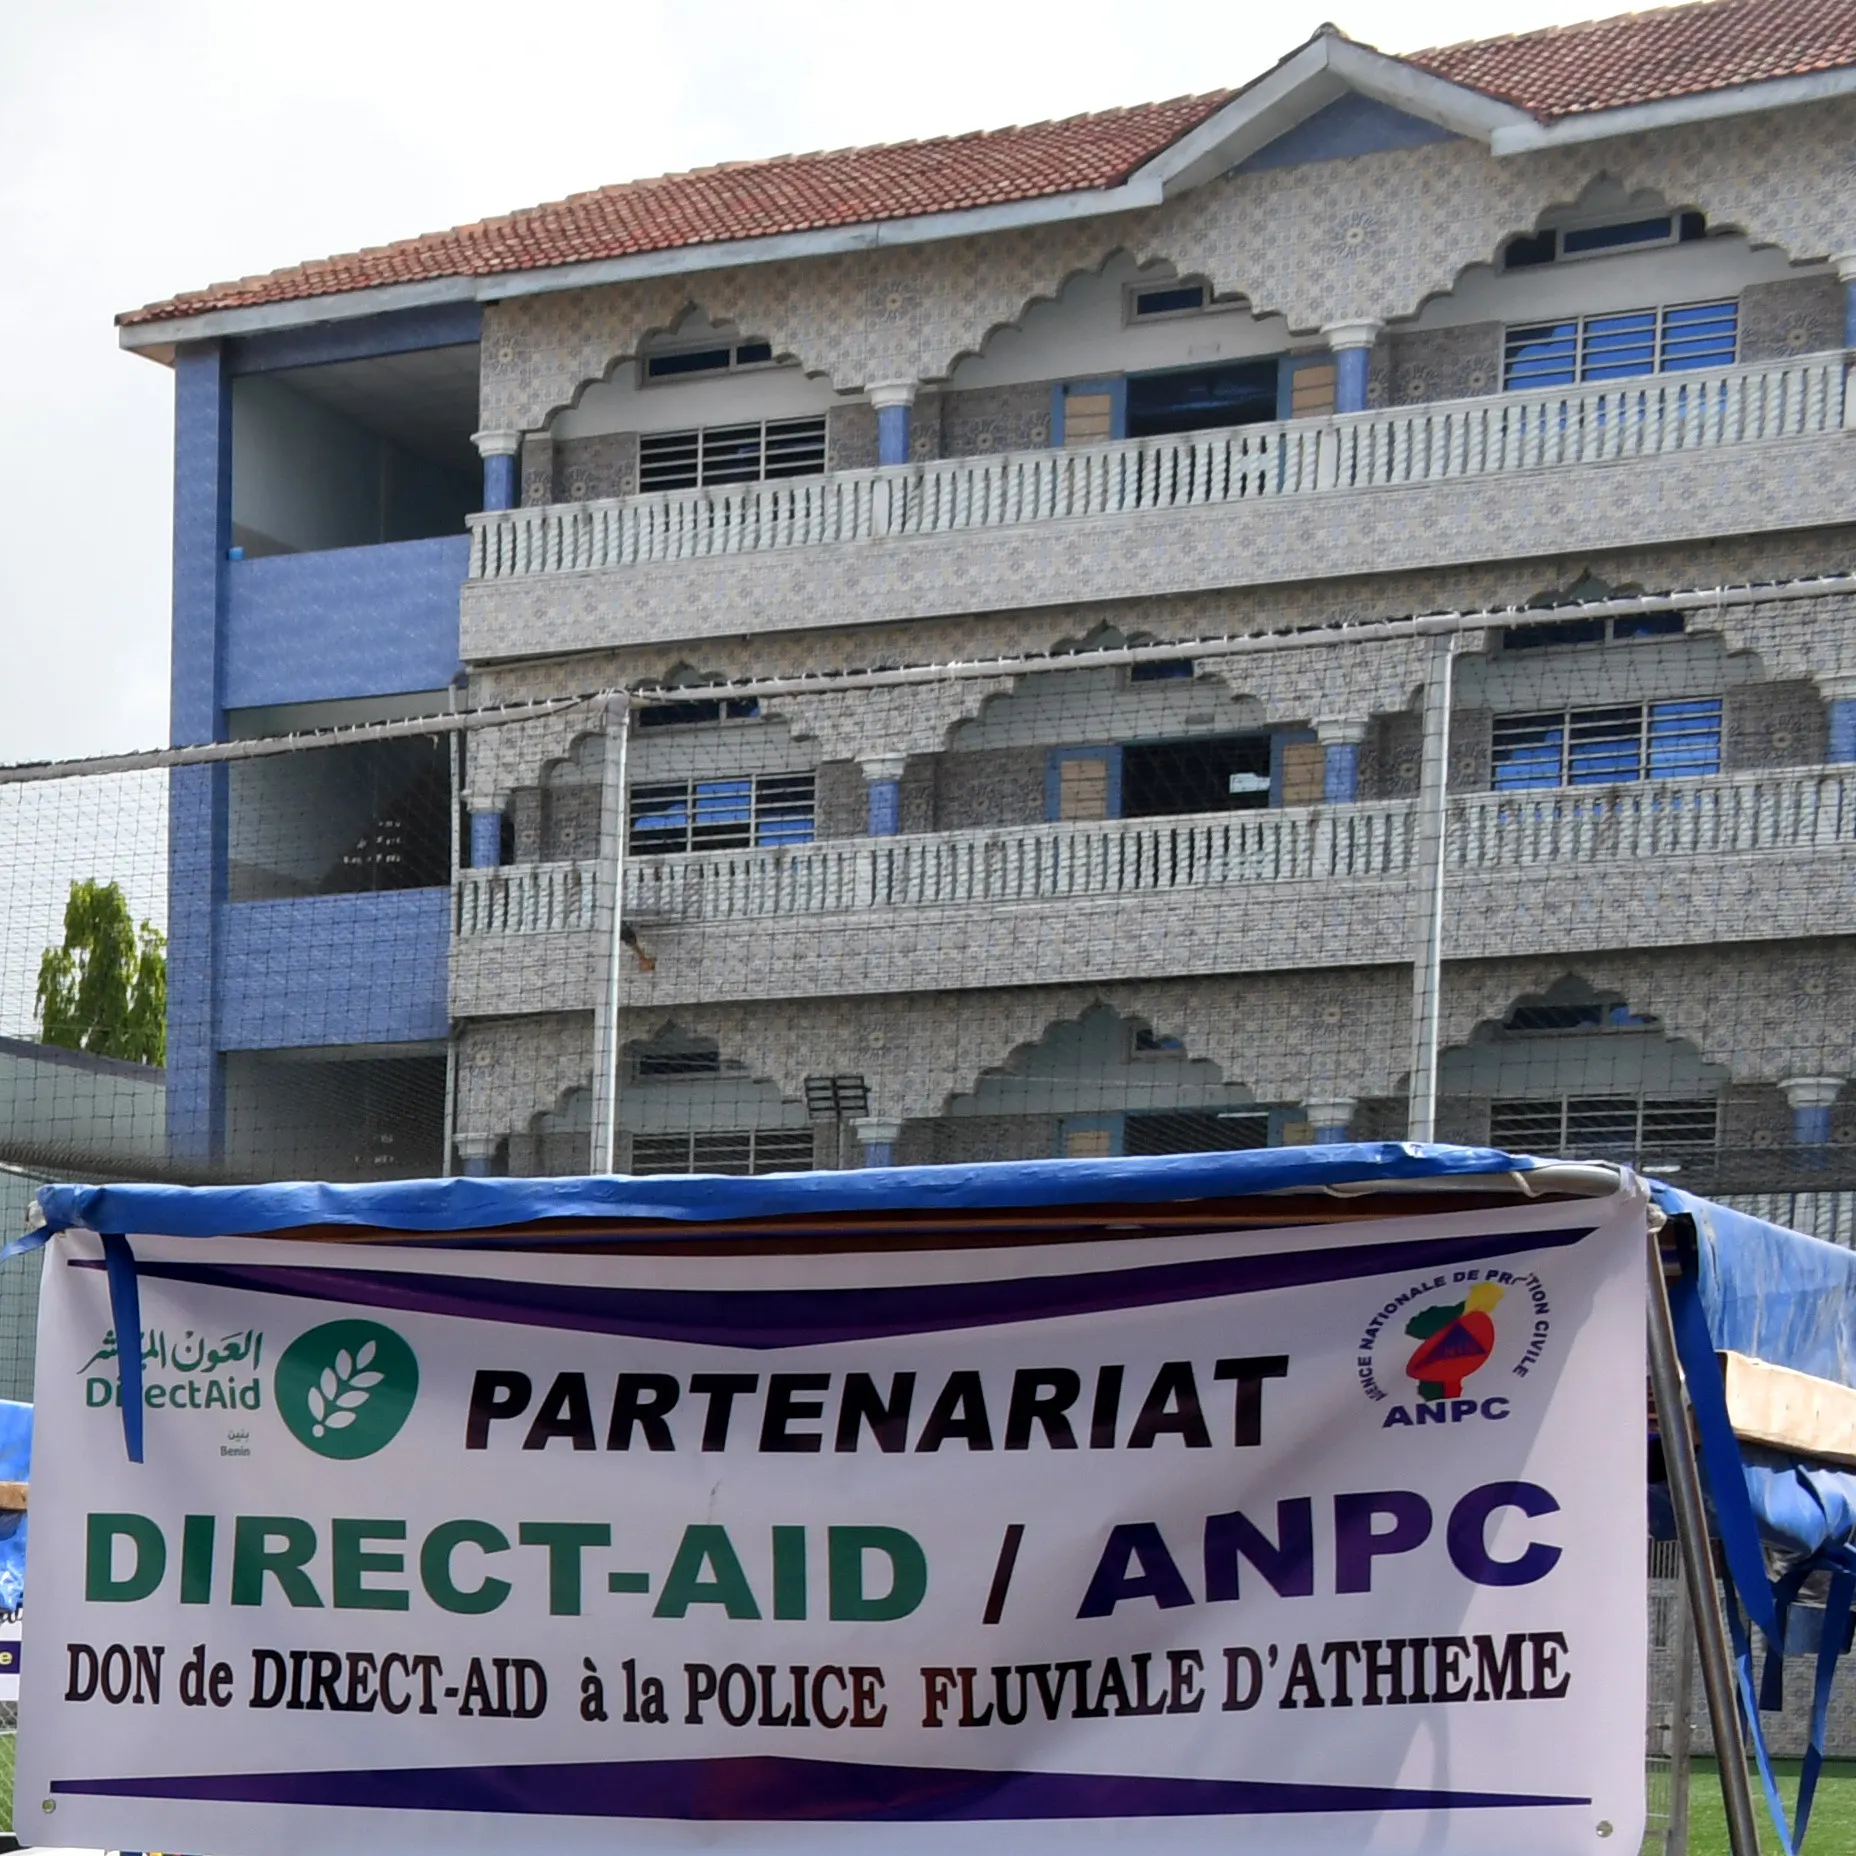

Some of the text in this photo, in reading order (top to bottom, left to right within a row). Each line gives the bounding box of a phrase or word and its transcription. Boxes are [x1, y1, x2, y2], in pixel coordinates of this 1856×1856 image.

[1359, 1276, 1447, 1350] NATIONALE
[1453, 1269, 1480, 1283] DE
[1513, 1320, 1550, 1378] CIVILE
[86, 1377, 262, 1411] DiectAid
[465, 1356, 1288, 1454] PARTENARIAT
[1382, 1397, 1511, 1428] ANPC
[220, 1446, 251, 1457] Benin
[85, 1512, 929, 1622] DIRECT-AID
[1076, 1480, 1563, 1619] ANPC
[65, 1631, 1571, 1728] DON de DIRECT-AID à la POLICE FLUVIALE D'ATHIEME
